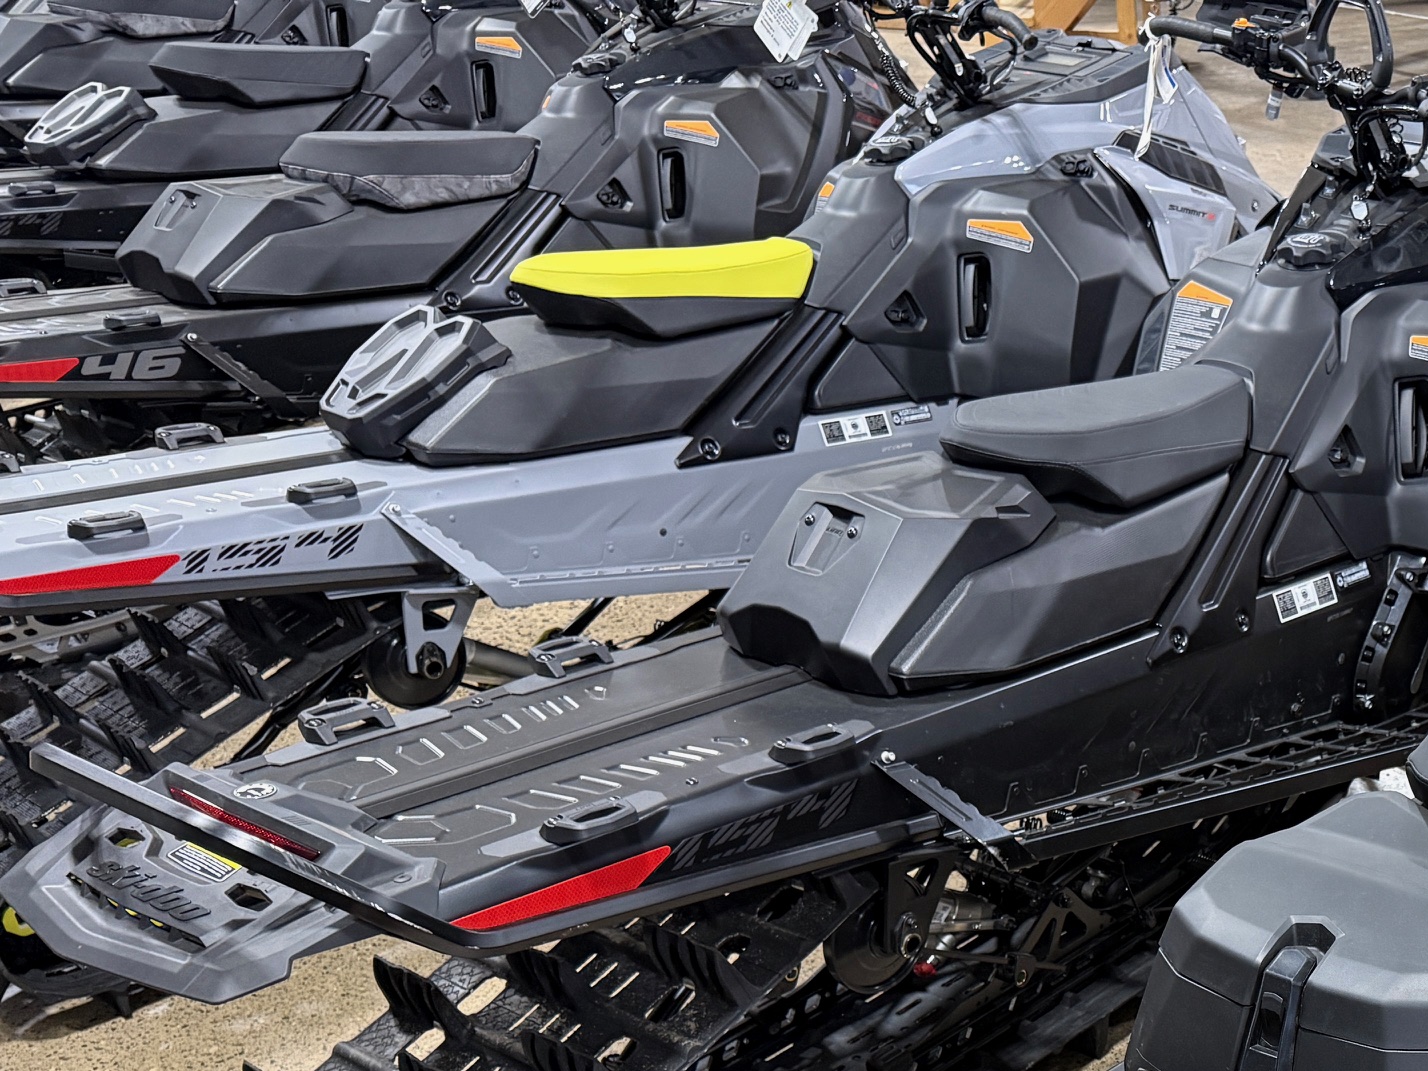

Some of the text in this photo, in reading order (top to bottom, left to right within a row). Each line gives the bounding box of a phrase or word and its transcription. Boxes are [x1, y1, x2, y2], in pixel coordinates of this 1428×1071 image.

[1168, 204, 1207, 218] SUMMIT
[81, 346, 186, 379] 46
[182, 523, 364, 575] 154
